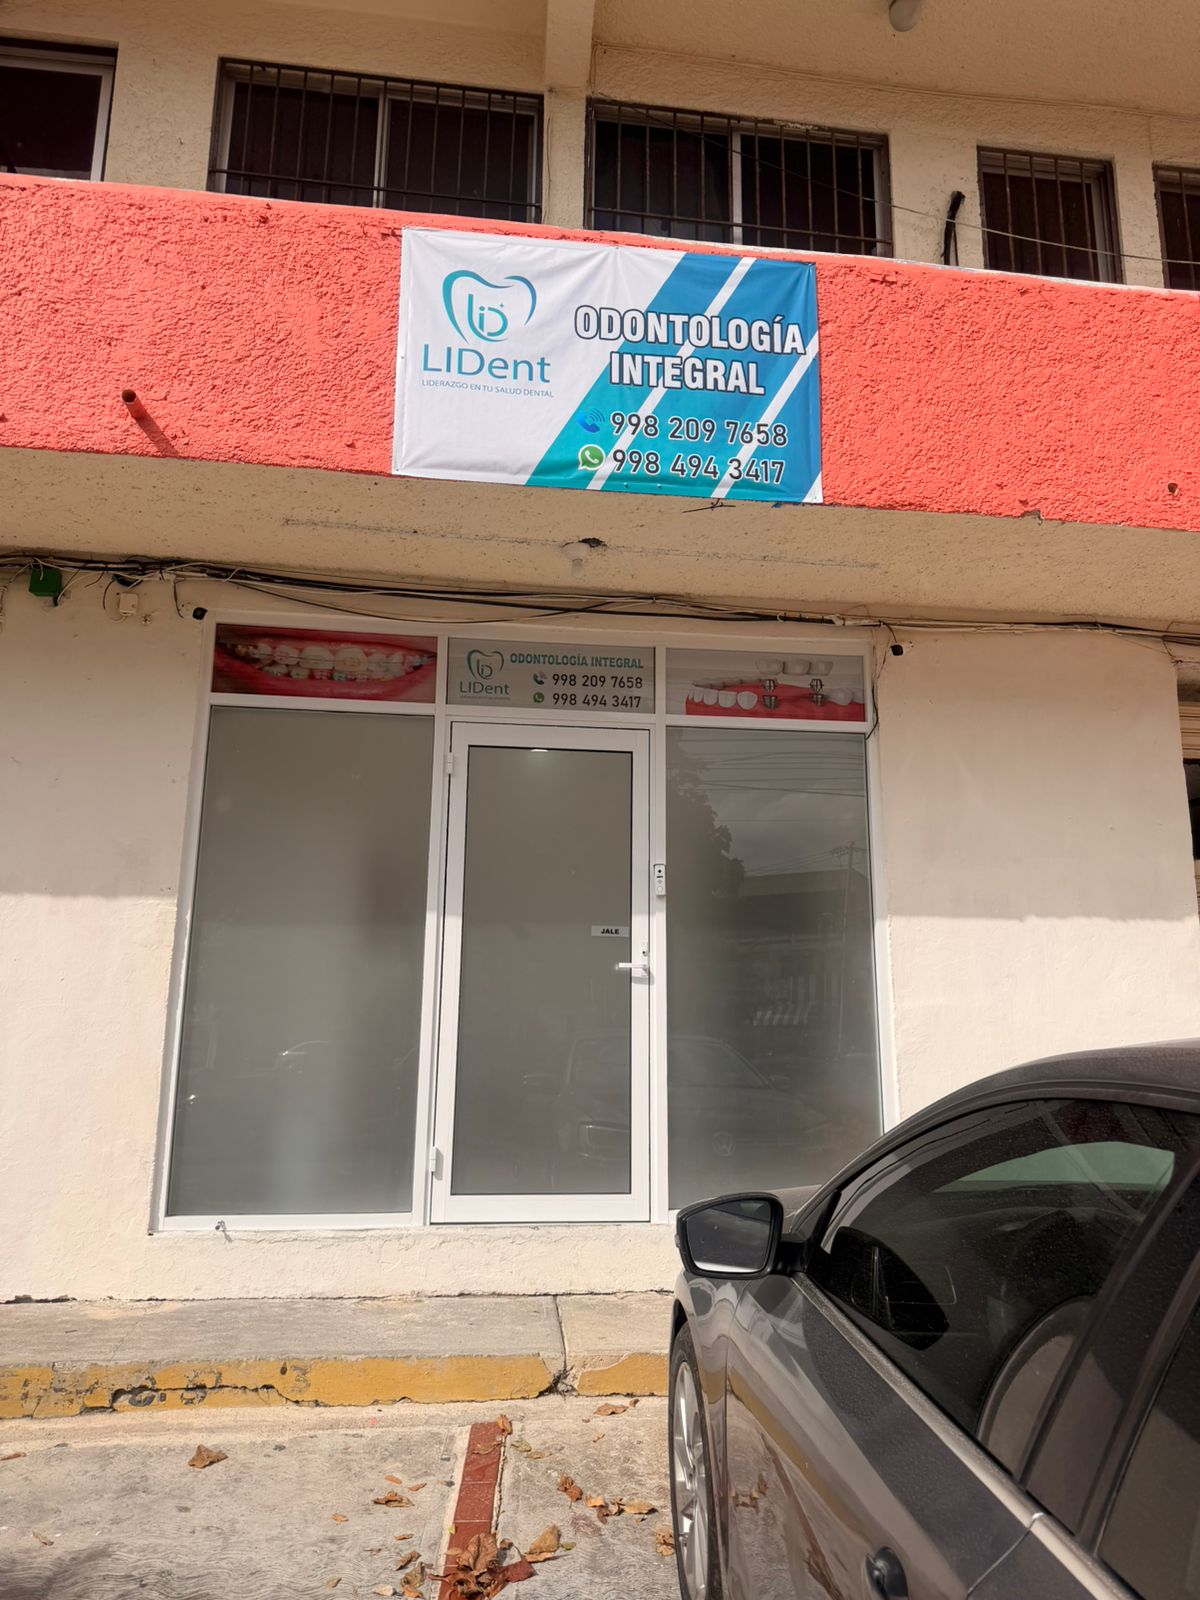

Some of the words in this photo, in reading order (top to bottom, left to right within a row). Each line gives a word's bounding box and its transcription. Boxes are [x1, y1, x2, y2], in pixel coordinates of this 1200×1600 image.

[575, 305, 806, 356] ODONTOLOGÍA
[422, 344, 551, 383] LIDent
[610, 351, 765, 395] INTEGRAL
[422, 379, 469, 389] LIDERAZGO
[470, 383, 481, 391] EN
[483, 384, 493, 393] TU
[495, 386, 522, 395] SALUD
[523, 388, 554, 398] DENTAL
[611, 411, 659, 438] 998
[668, 416, 716, 442] 209
[724, 420, 788, 447] 7658
[612, 449, 660, 475] 998
[670, 453, 718, 479] 494
[728, 458, 785, 484] 3417
[510, 653, 588, 667] ODONTOLOGÍA
[591, 657, 644, 669] INTEGRAL
[459, 681, 510, 696] LIDent
[552, 673, 577, 687] 998
[582, 675, 606, 688] 209
[611, 676, 643, 689] 7658
[552, 693, 577, 706] 998
[582, 694, 607, 707] 494
[612, 695, 641, 708] 3417
